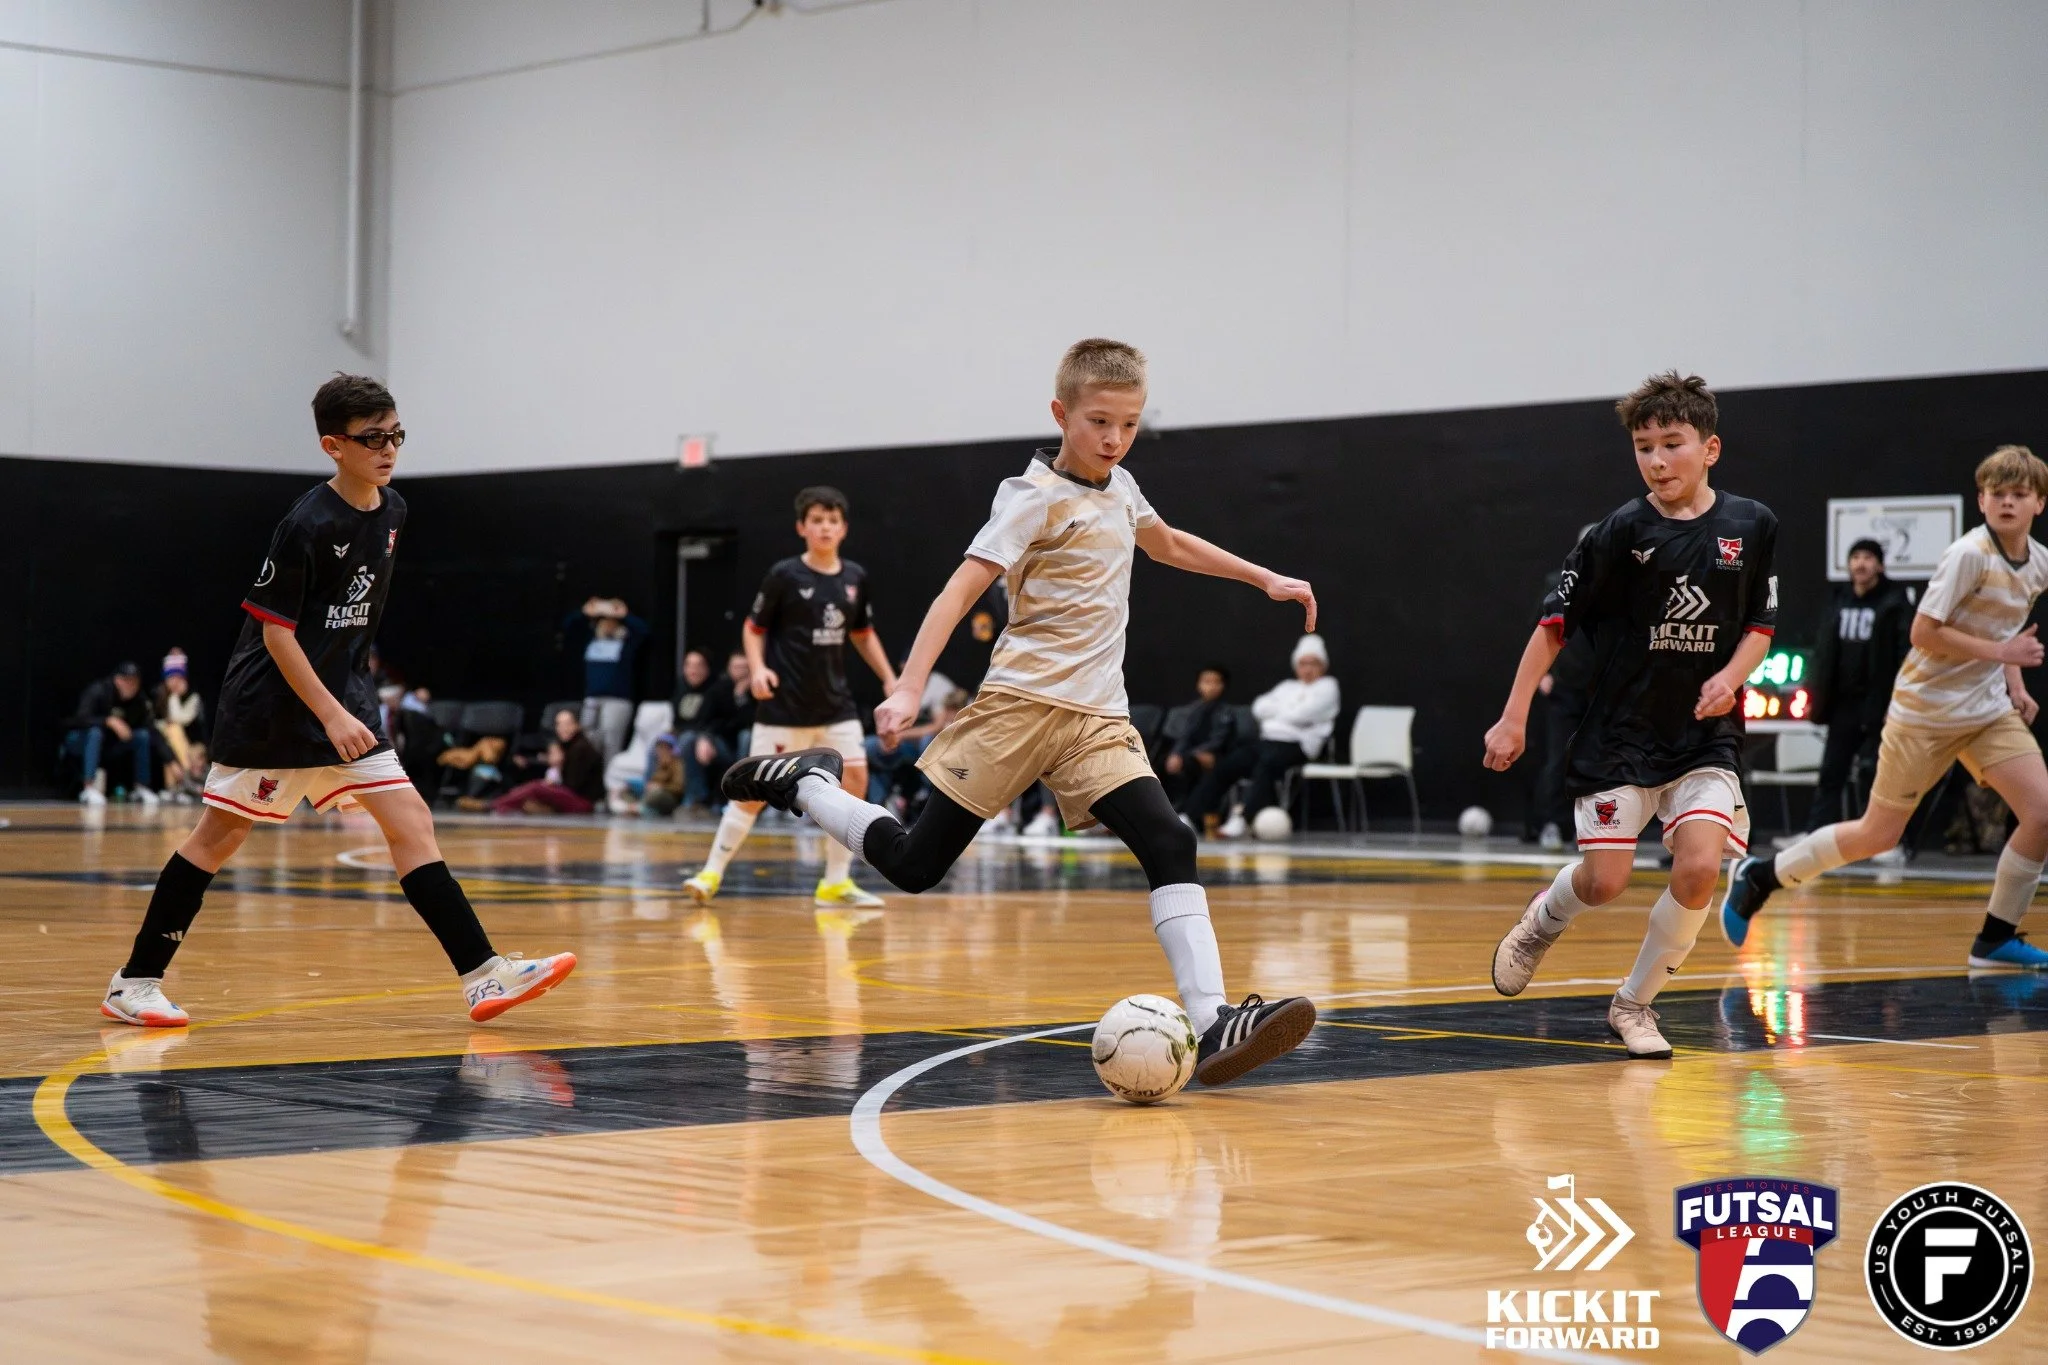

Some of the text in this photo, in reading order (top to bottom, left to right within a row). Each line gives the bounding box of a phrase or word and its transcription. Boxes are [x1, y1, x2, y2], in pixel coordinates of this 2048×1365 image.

[1715, 558, 1744, 567] TEKKERS
[327, 602, 371, 620] KICIT
[1649, 638, 1716, 653] ORWARD
